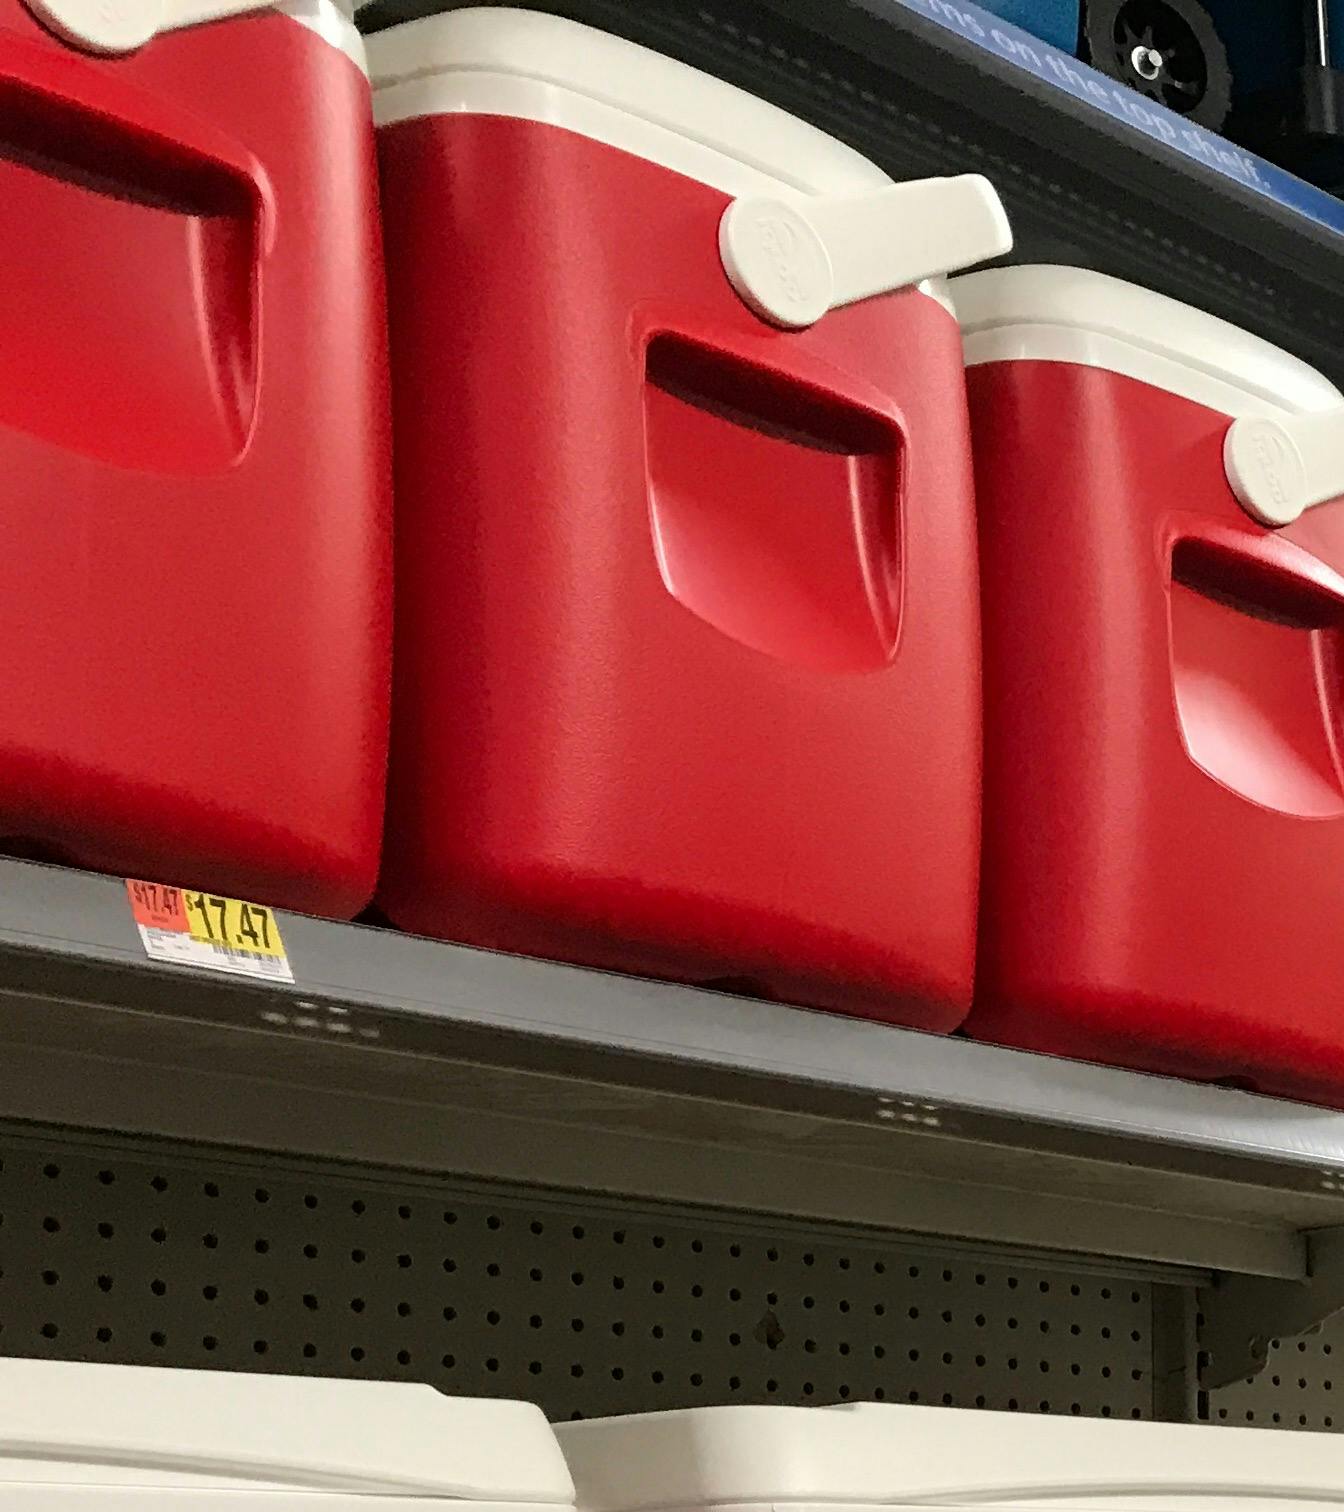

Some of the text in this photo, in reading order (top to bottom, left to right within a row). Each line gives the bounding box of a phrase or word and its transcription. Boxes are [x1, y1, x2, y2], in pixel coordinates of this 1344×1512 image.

[1113, 90, 1177, 139] top
[133, 883, 179, 917] $17.47
[185, 893, 270, 949] $17.47
